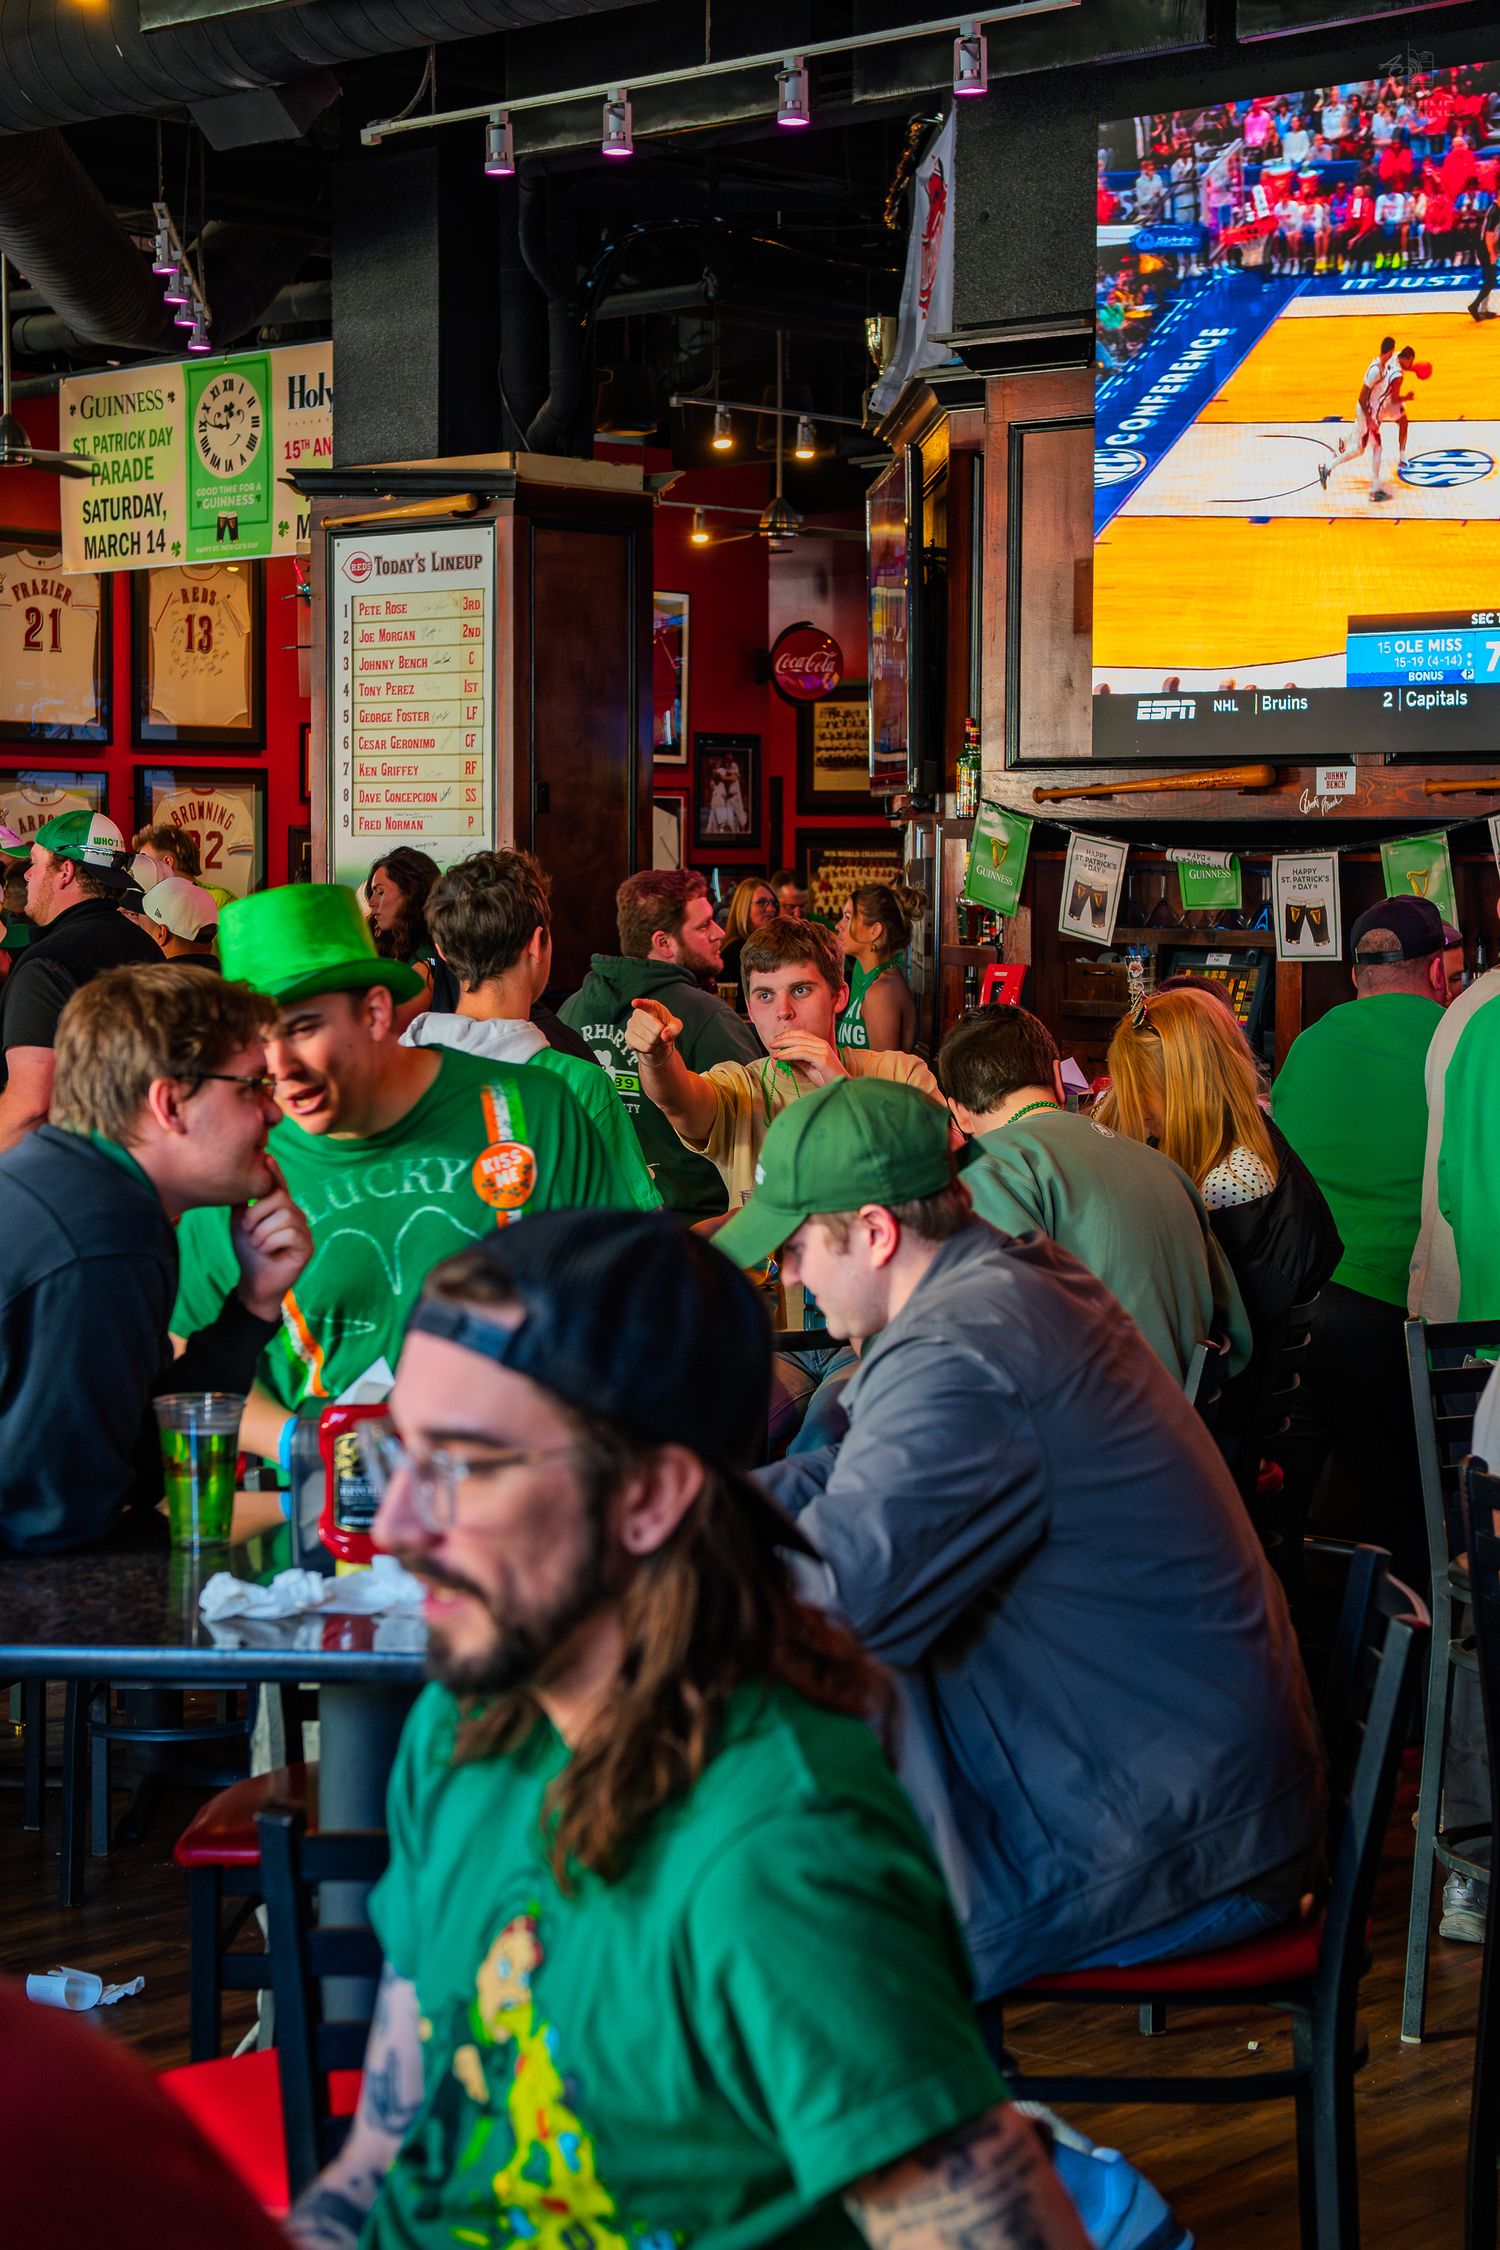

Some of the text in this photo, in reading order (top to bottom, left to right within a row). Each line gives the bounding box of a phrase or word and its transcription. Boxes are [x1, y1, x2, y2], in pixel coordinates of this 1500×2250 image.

[1341, 275, 1472, 290] IT JUST
[1105, 327, 1232, 445] CONFERENCE
[80, 389, 164, 420] GUINNESS
[73, 426, 173, 456] ST. PATRICK DAY
[285, 438, 310, 460] 15TH
[91, 456, 155, 487] PARADE
[196, 482, 262, 497] GOOD TIME FOR A
[82, 492, 167, 525] SATURDAY,
[202, 494, 255, 509] GUINNESS
[84, 529, 166, 561] MARCH 14
[351, 551, 483, 576] REDS TODAY'S LINEUP
[11, 578, 73, 607] FRAZIER
[181, 586, 217, 606] REDS
[343, 604, 348, 618] 1
[359, 603, 381, 616] PETE
[386, 601, 408, 615] ROSE
[463, 596, 481, 611] 3RD
[1471, 612, 1494, 625] SEC
[23, 606, 63, 653] 21
[184, 613, 214, 654] 13
[343, 630, 349, 644] 2
[359, 629, 375, 643] JOE
[379, 628, 416, 643] MORGAN
[463, 624, 481, 638] 2ND
[1377, 638, 1463, 654] 15 OLE MISS
[343, 657, 349, 670] 3
[359, 657, 395, 671] JOHNNY
[399, 655, 428, 669] BENCH
[468, 651, 475, 665] C
[775, 651, 838, 674] Coca-Cola
[1394, 654, 1463, 668] 15-19 (4-14)
[1408, 670, 1444, 682] BONUS
[343, 683, 350, 697] 4
[359, 683, 381, 697] TONY
[386, 682, 414, 696] PEREZ
[1136, 695, 1308, 721] ESPN NHL Bruins
[1382, 690, 1468, 710] 2 Capitals
[343, 710, 349, 724] 5
[359, 709, 392, 723] GEORGE
[396, 708, 429, 722] FOSTER
[466, 706, 478, 721] LF
[343, 733, 477, 750] 6 CESAR GERONIMO CF
[343, 761, 477, 777] 7 KEN GRIFFEY RF
[1324, 771, 1348, 780] JOHNNY
[1326, 780, 1346, 789] BENCH
[343, 788, 349, 802] 8
[359, 790, 381, 803] DAVE
[385, 789, 437, 803] CONCEPCION
[465, 788, 477, 802] SS
[171, 801, 235, 831] BROWNING
[343, 814, 349, 828] 9
[359, 816, 381, 830] FRED
[385, 816, 423, 830] NORMAN
[468, 815, 474, 828] P
[1085, 857, 1118, 870] PATRICK'S
[1086, 849, 1108, 860] HAPPY
[976, 864, 1013, 886] GUINNESS
[1087, 865, 1101, 873] DAY
[1189, 868, 1231, 879] GUINNESS
[1293, 875, 1330, 883] PATRICK'S
[481, 1149, 523, 1176] KISS
[494, 1166, 520, 1188] ME
[293, 1156, 470, 1226] LUCKY
